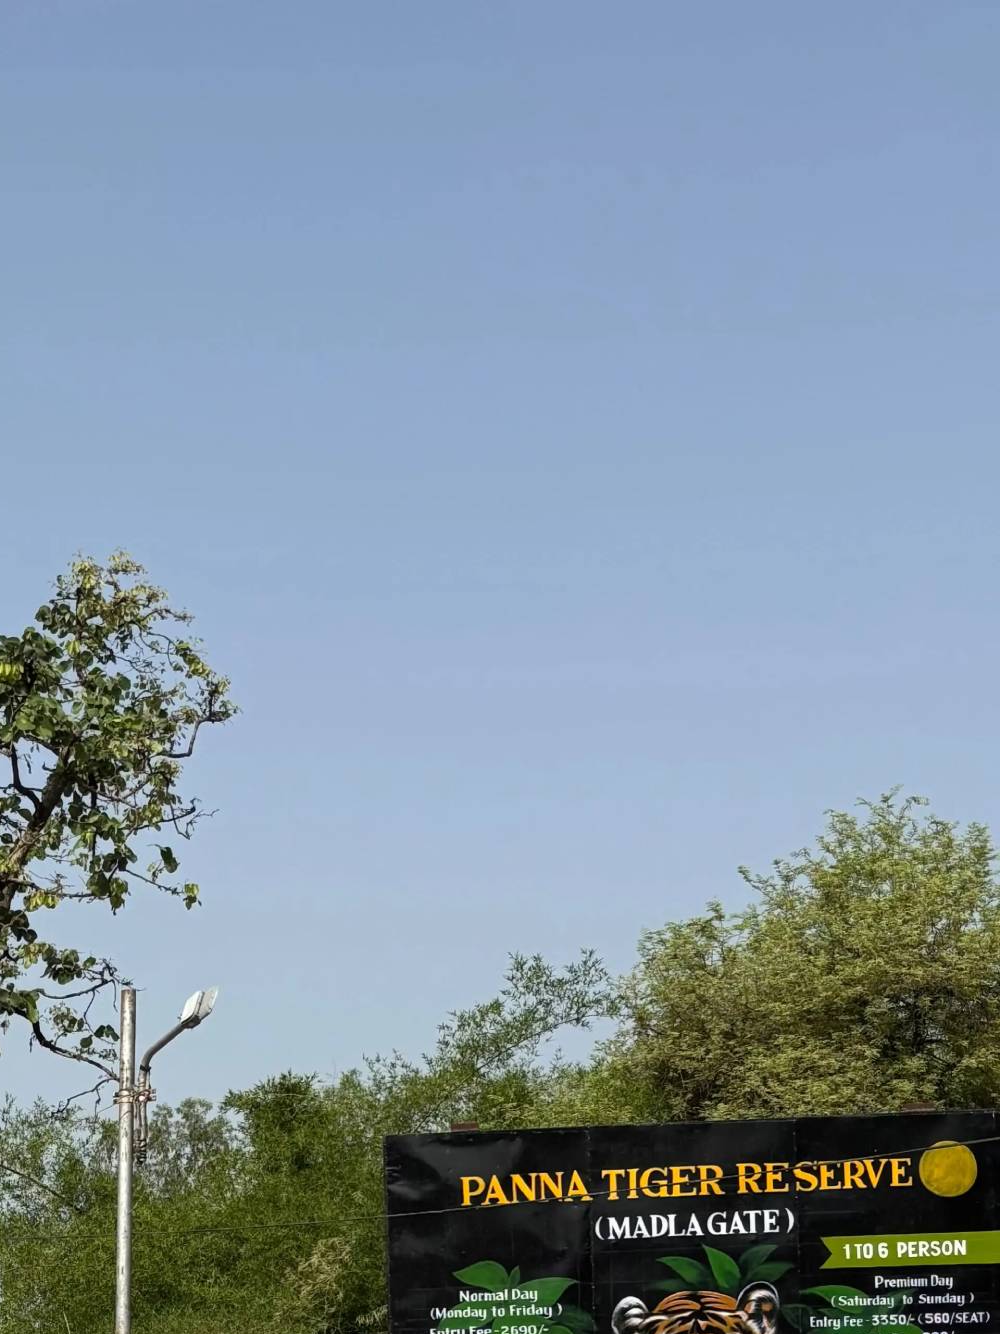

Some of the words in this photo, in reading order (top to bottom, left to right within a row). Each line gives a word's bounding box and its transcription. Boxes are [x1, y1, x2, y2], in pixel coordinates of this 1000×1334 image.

[459, 1169, 593, 1207] PANNA
[601, 1165, 725, 1200] TIGER
[735, 1157, 914, 1194] RESERVE
[843, 1244, 851, 1259] 1
[854, 1243, 874, 1259] TO
[878, 1242, 889, 1258] 6
[897, 1239, 967, 1258] PERSON
[874, 1275, 928, 1289] Premium
[930, 1274, 953, 1289] Day
[459, 1289, 508, 1302] Normal
[511, 1288, 538, 1301] Day
[903, 1293, 913, 1304] to
[430, 1307, 487, 1320] (Monday
[491, 1306, 506, 1317] to
[809, 1316, 841, 1329] Entry
[843, 1316, 863, 1327] Fee
